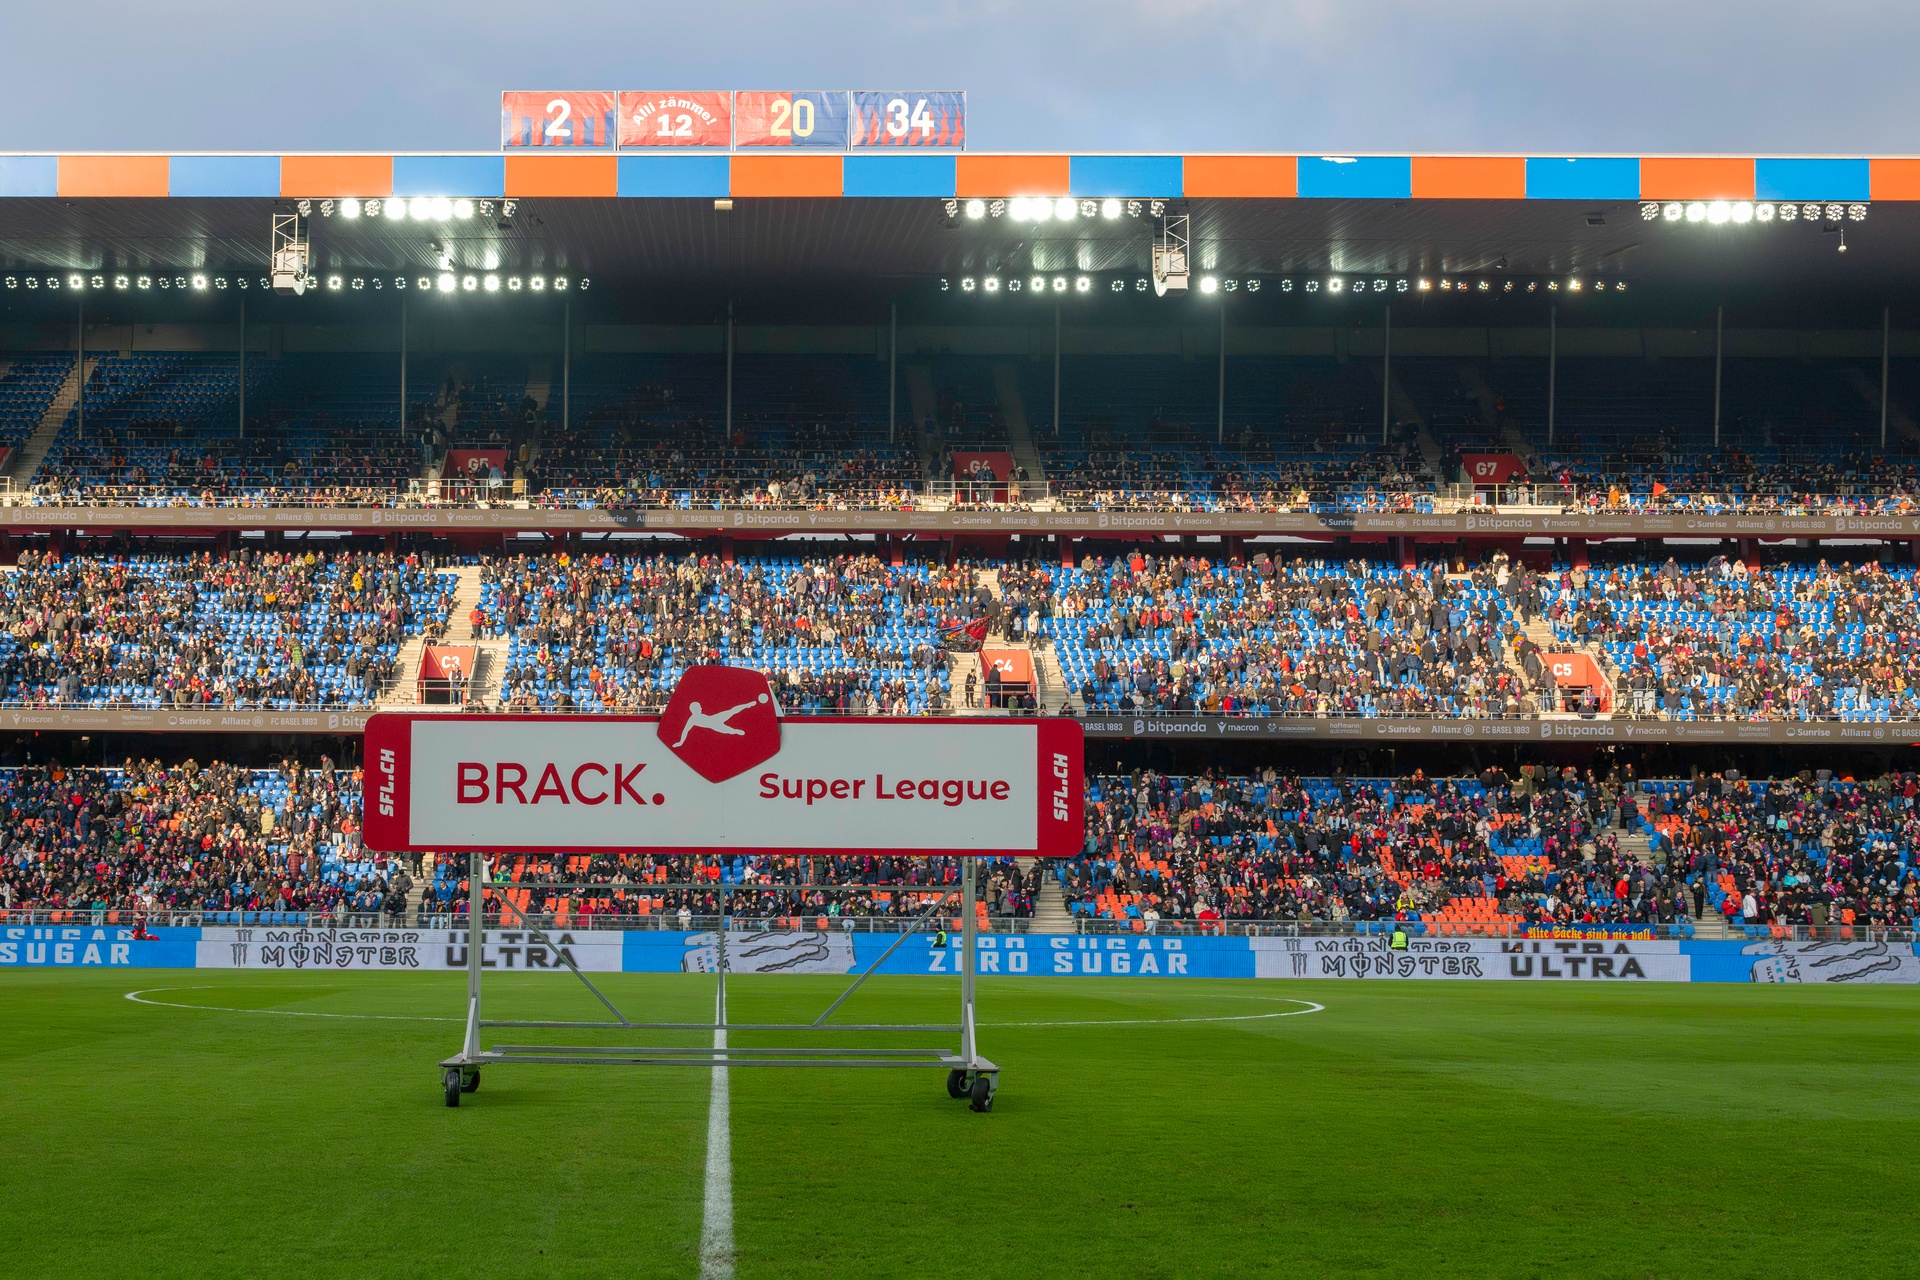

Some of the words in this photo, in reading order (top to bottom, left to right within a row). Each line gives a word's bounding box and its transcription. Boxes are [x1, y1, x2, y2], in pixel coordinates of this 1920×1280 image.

[545, 99, 572, 136] 2
[632, 99, 656, 126] Alli
[659, 96, 718, 126] zämme!
[886, 98, 934, 136] 34
[770, 99, 814, 137] 20
[656, 114, 693, 137] 12
[1476, 462, 1497, 476] G7
[25, 510, 77, 522] bitpanda
[384, 512, 437, 524] bitpanda
[747, 514, 800, 526] bitpanda
[1112, 516, 1164, 528] bitpanda
[1328, 518, 1358, 526] Sunrise
[1479, 517, 1532, 530] bitpanda
[1696, 520, 1727, 528] Sunrise
[1736, 520, 1764, 528] Allianz
[1848, 518, 1902, 532] bitpanda
[442, 656, 460, 668] C3
[1553, 663, 1572, 676] C5
[179, 717, 212, 726] Sunrise
[221, 716, 250, 726] Allianz
[270, 718, 280, 726] FC
[281, 718, 300, 726] BASEL
[302, 718, 317, 726] 1893
[1148, 720, 1206, 734] bitpanda
[1388, 725, 1421, 734] Sunrise
[1432, 725, 1462, 734] Allianz
[1482, 726, 1491, 734] FC
[1492, 726, 1512, 734] BASEL
[1514, 726, 1530, 734] 1893
[1555, 724, 1614, 738] bitpanda
[1797, 728, 1830, 737] Sunrise
[1841, 728, 1871, 737] Allianz
[1892, 729, 1900, 737] FC
[380, 748, 394, 816] SFL.CH
[457, 762, 665, 806] BRACK.
[1054, 753, 1068, 822] SFL.CH
[759, 773, 865, 806] Super
[876, 774, 1010, 806] League
[1528, 927, 1549, 939] Alte
[1586, 928, 1608, 940] sind
[1612, 928, 1628, 940] nie
[1631, 928, 1652, 940] voll
[0, 942, 130, 964] SUGAR
[1054, 952, 1188, 974] SUGAR
[1510, 956, 1646, 978] ULTRA
